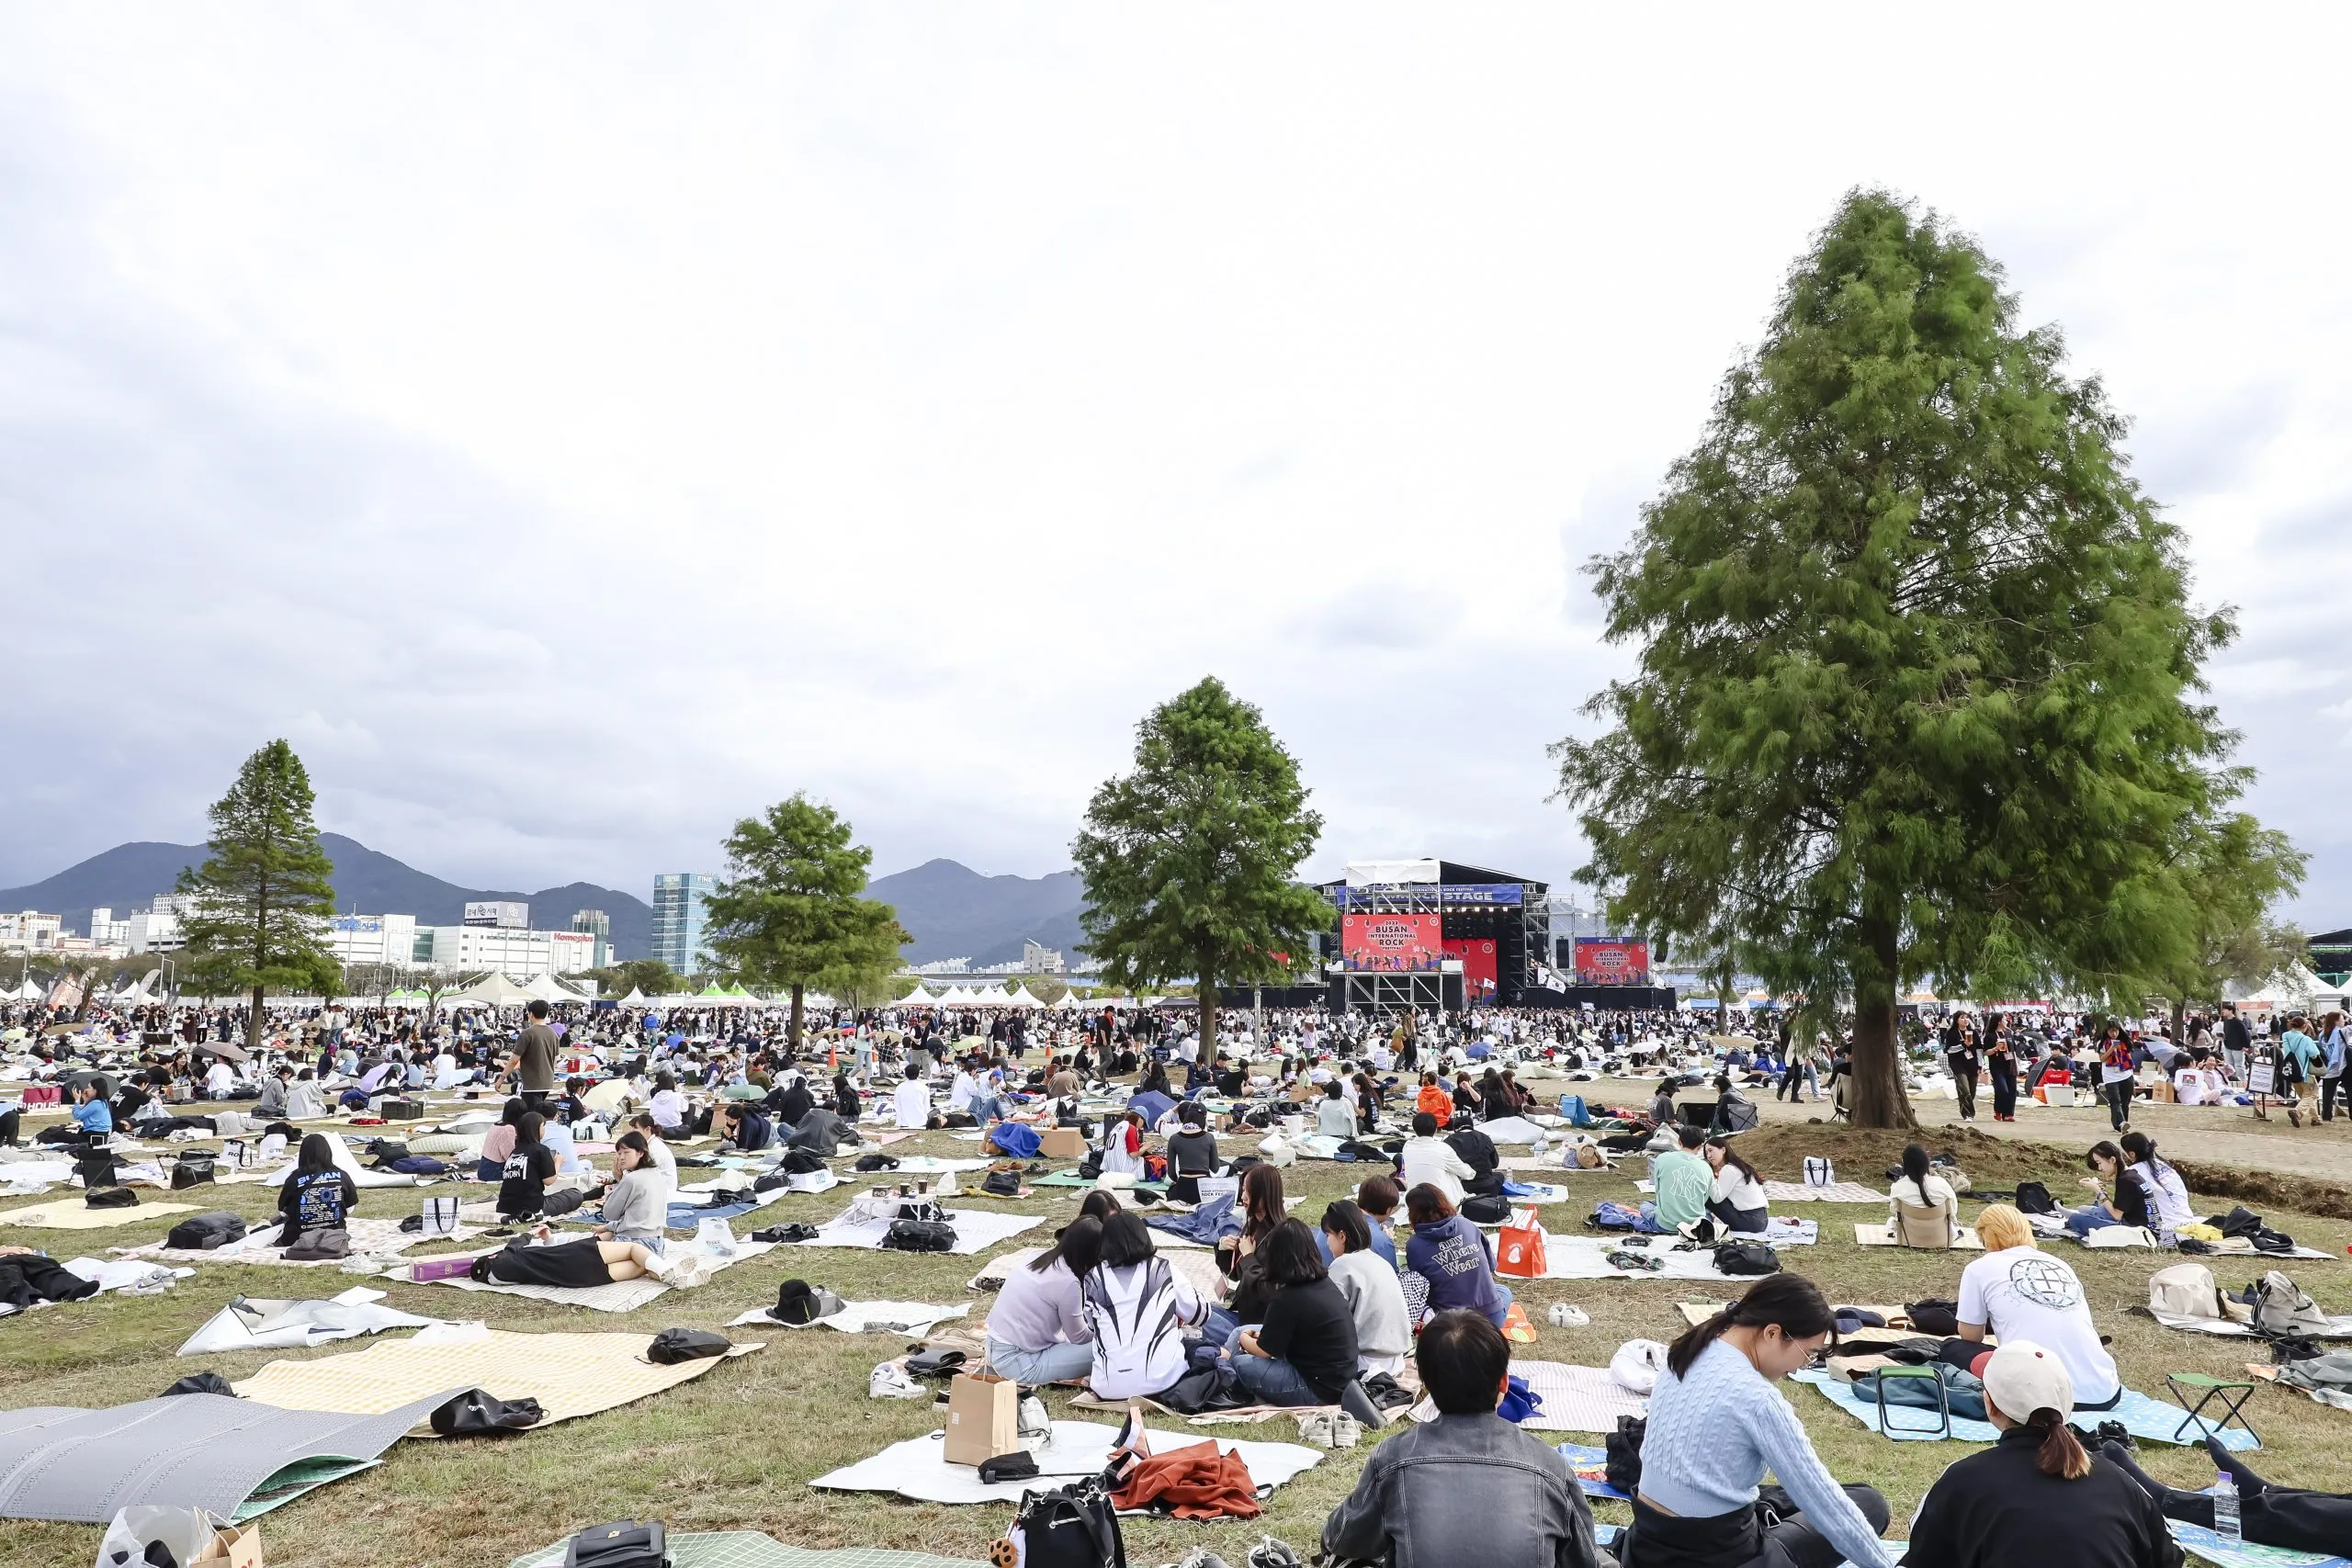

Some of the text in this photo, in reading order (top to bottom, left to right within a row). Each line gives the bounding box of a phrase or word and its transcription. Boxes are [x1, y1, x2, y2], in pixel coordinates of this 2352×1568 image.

[1443, 892, 1493, 901] STAGE
[553, 932, 594, 943] Homeplus
[1669, 1166, 1699, 1201] NY
[1439, 1234, 1464, 1251] any
[1431, 1243, 1480, 1266] Where
[1442, 1257, 1480, 1278] Wear
